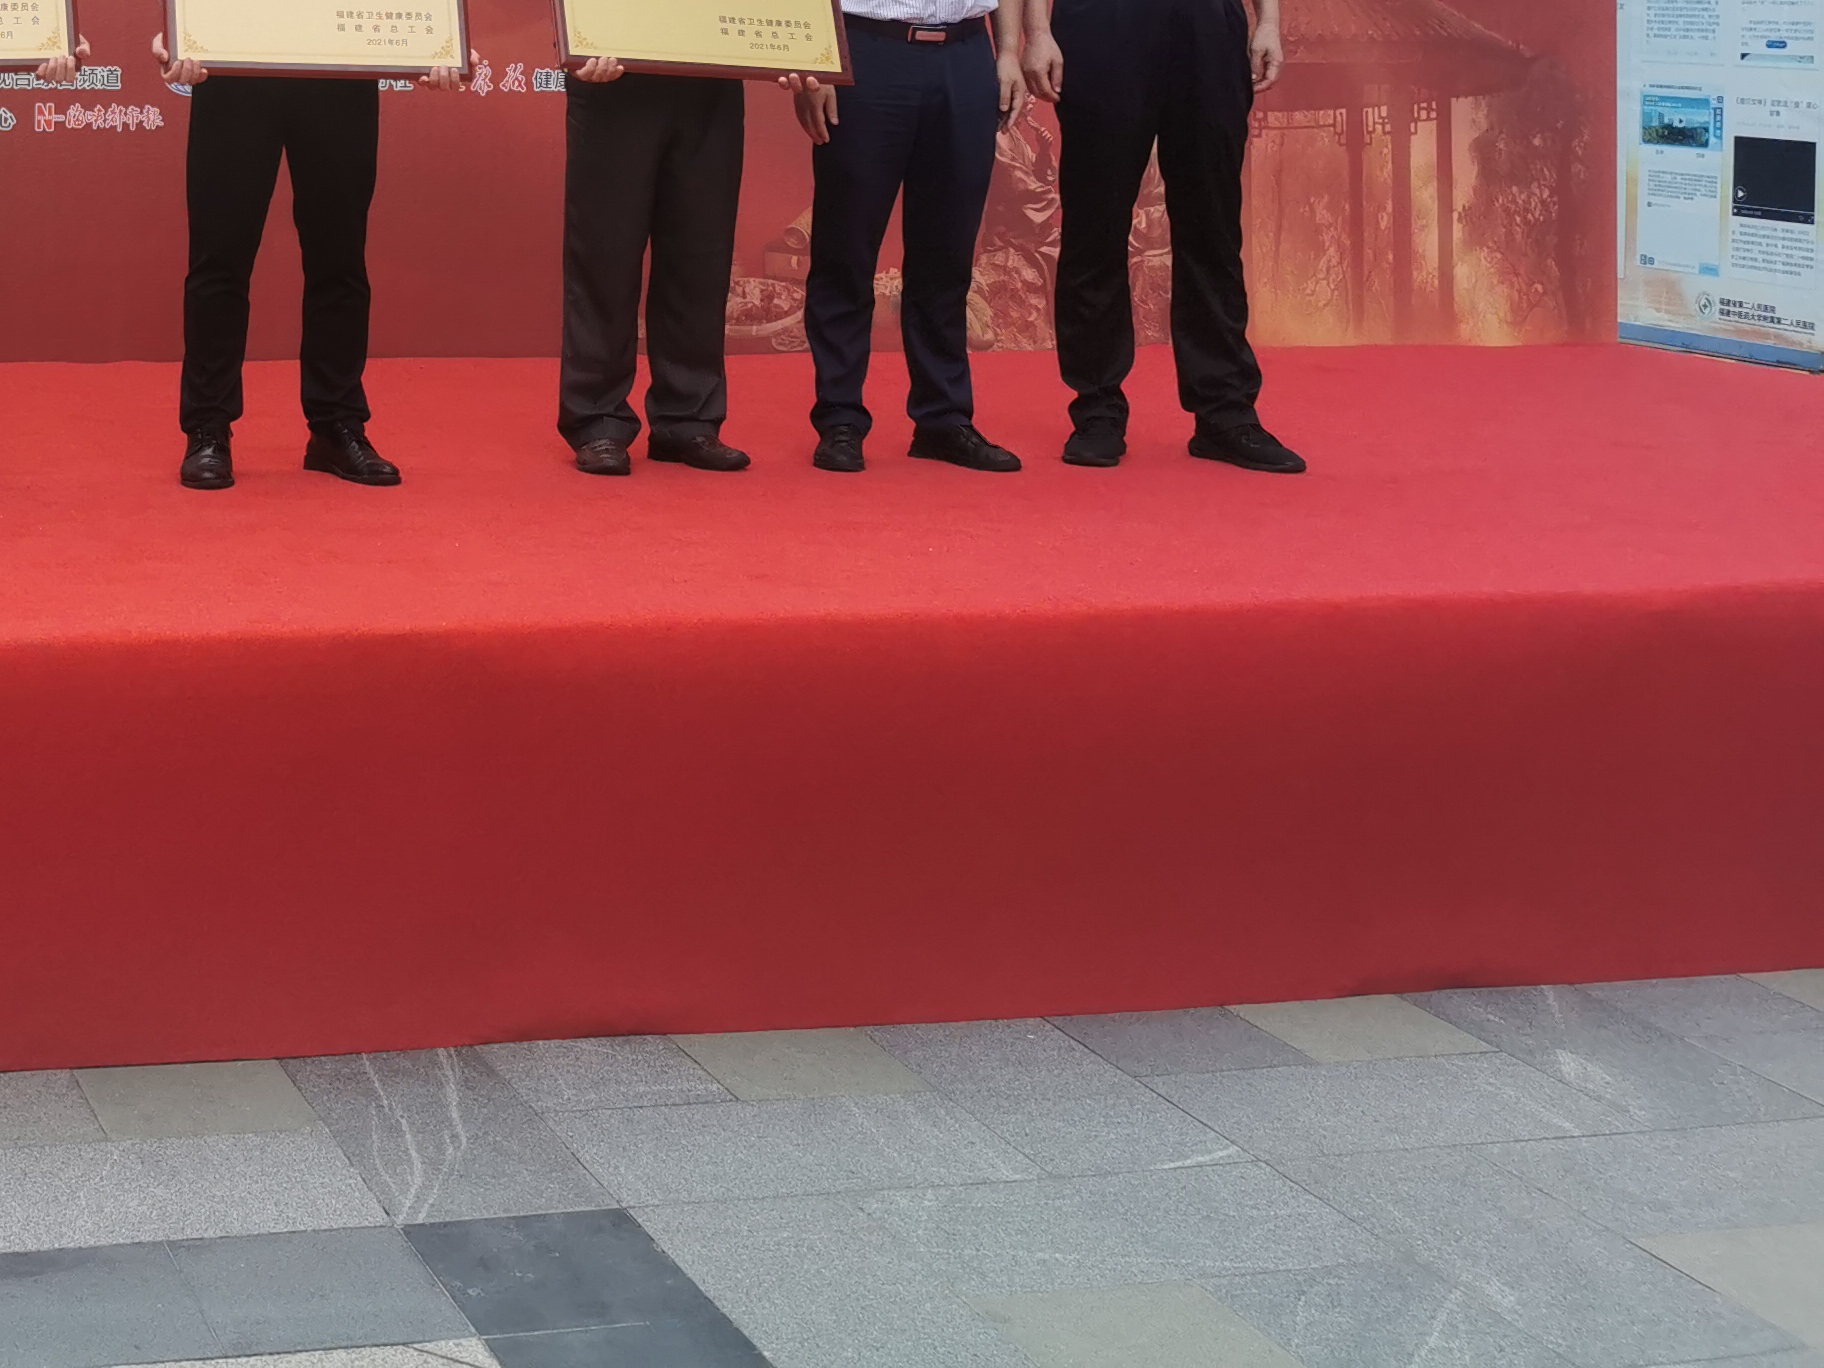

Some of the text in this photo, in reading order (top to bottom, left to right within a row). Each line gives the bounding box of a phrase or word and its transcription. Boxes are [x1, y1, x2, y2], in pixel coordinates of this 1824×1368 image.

[336, 10, 433, 22] 福建省卫生健康委员会
[718, 15, 812, 30] 福建省卫生健康委员会
[336, 23, 434, 35] 福建省总工会
[719, 27, 814, 42] 福建省总工会
[366, 38, 409, 48] 2021年6月
[749, 42, 790, 53] 2021年6月
